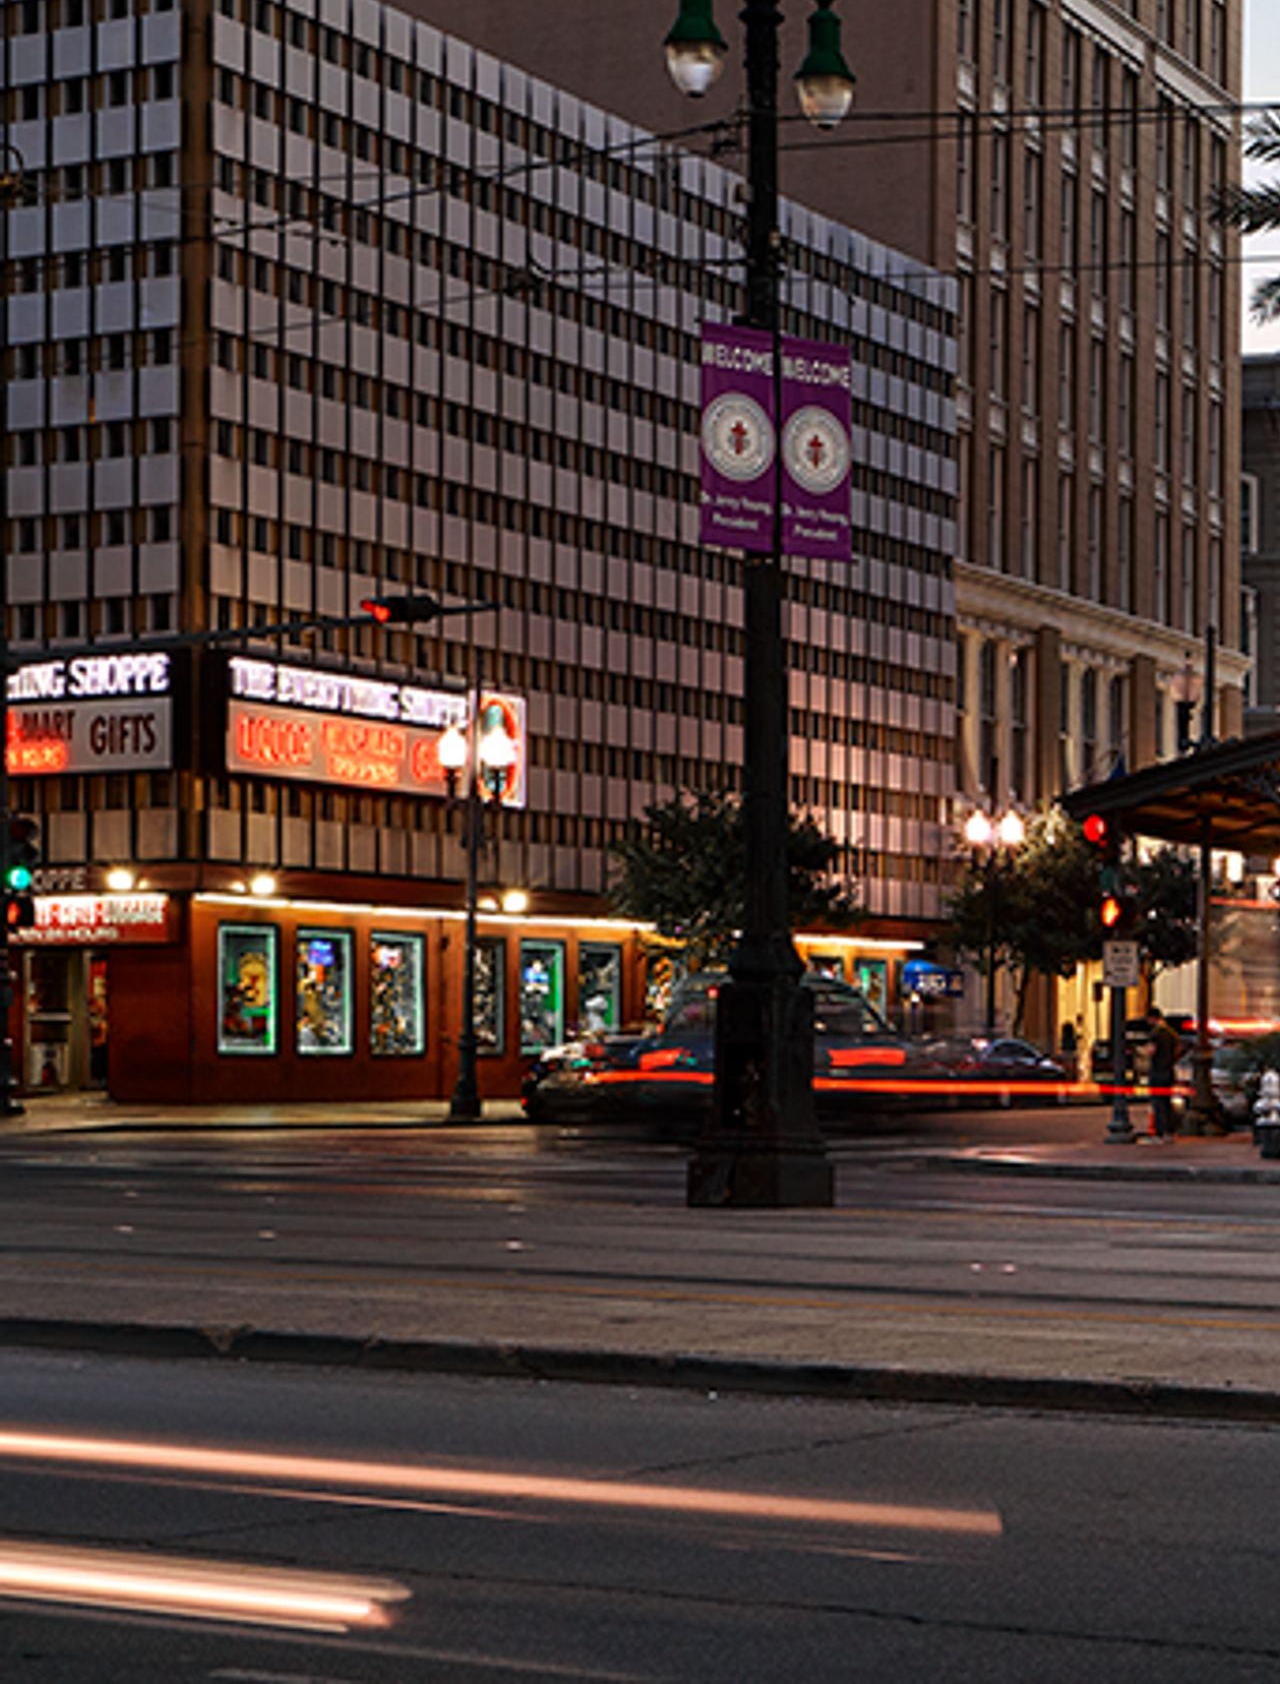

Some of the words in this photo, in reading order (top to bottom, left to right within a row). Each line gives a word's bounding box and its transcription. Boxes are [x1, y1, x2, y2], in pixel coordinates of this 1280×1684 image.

[67, 651, 171, 698] SHOPPE
[228, 655, 276, 700] THE
[277, 663, 400, 721] EVERYTHING
[89, 712, 156, 756] GIFTS
